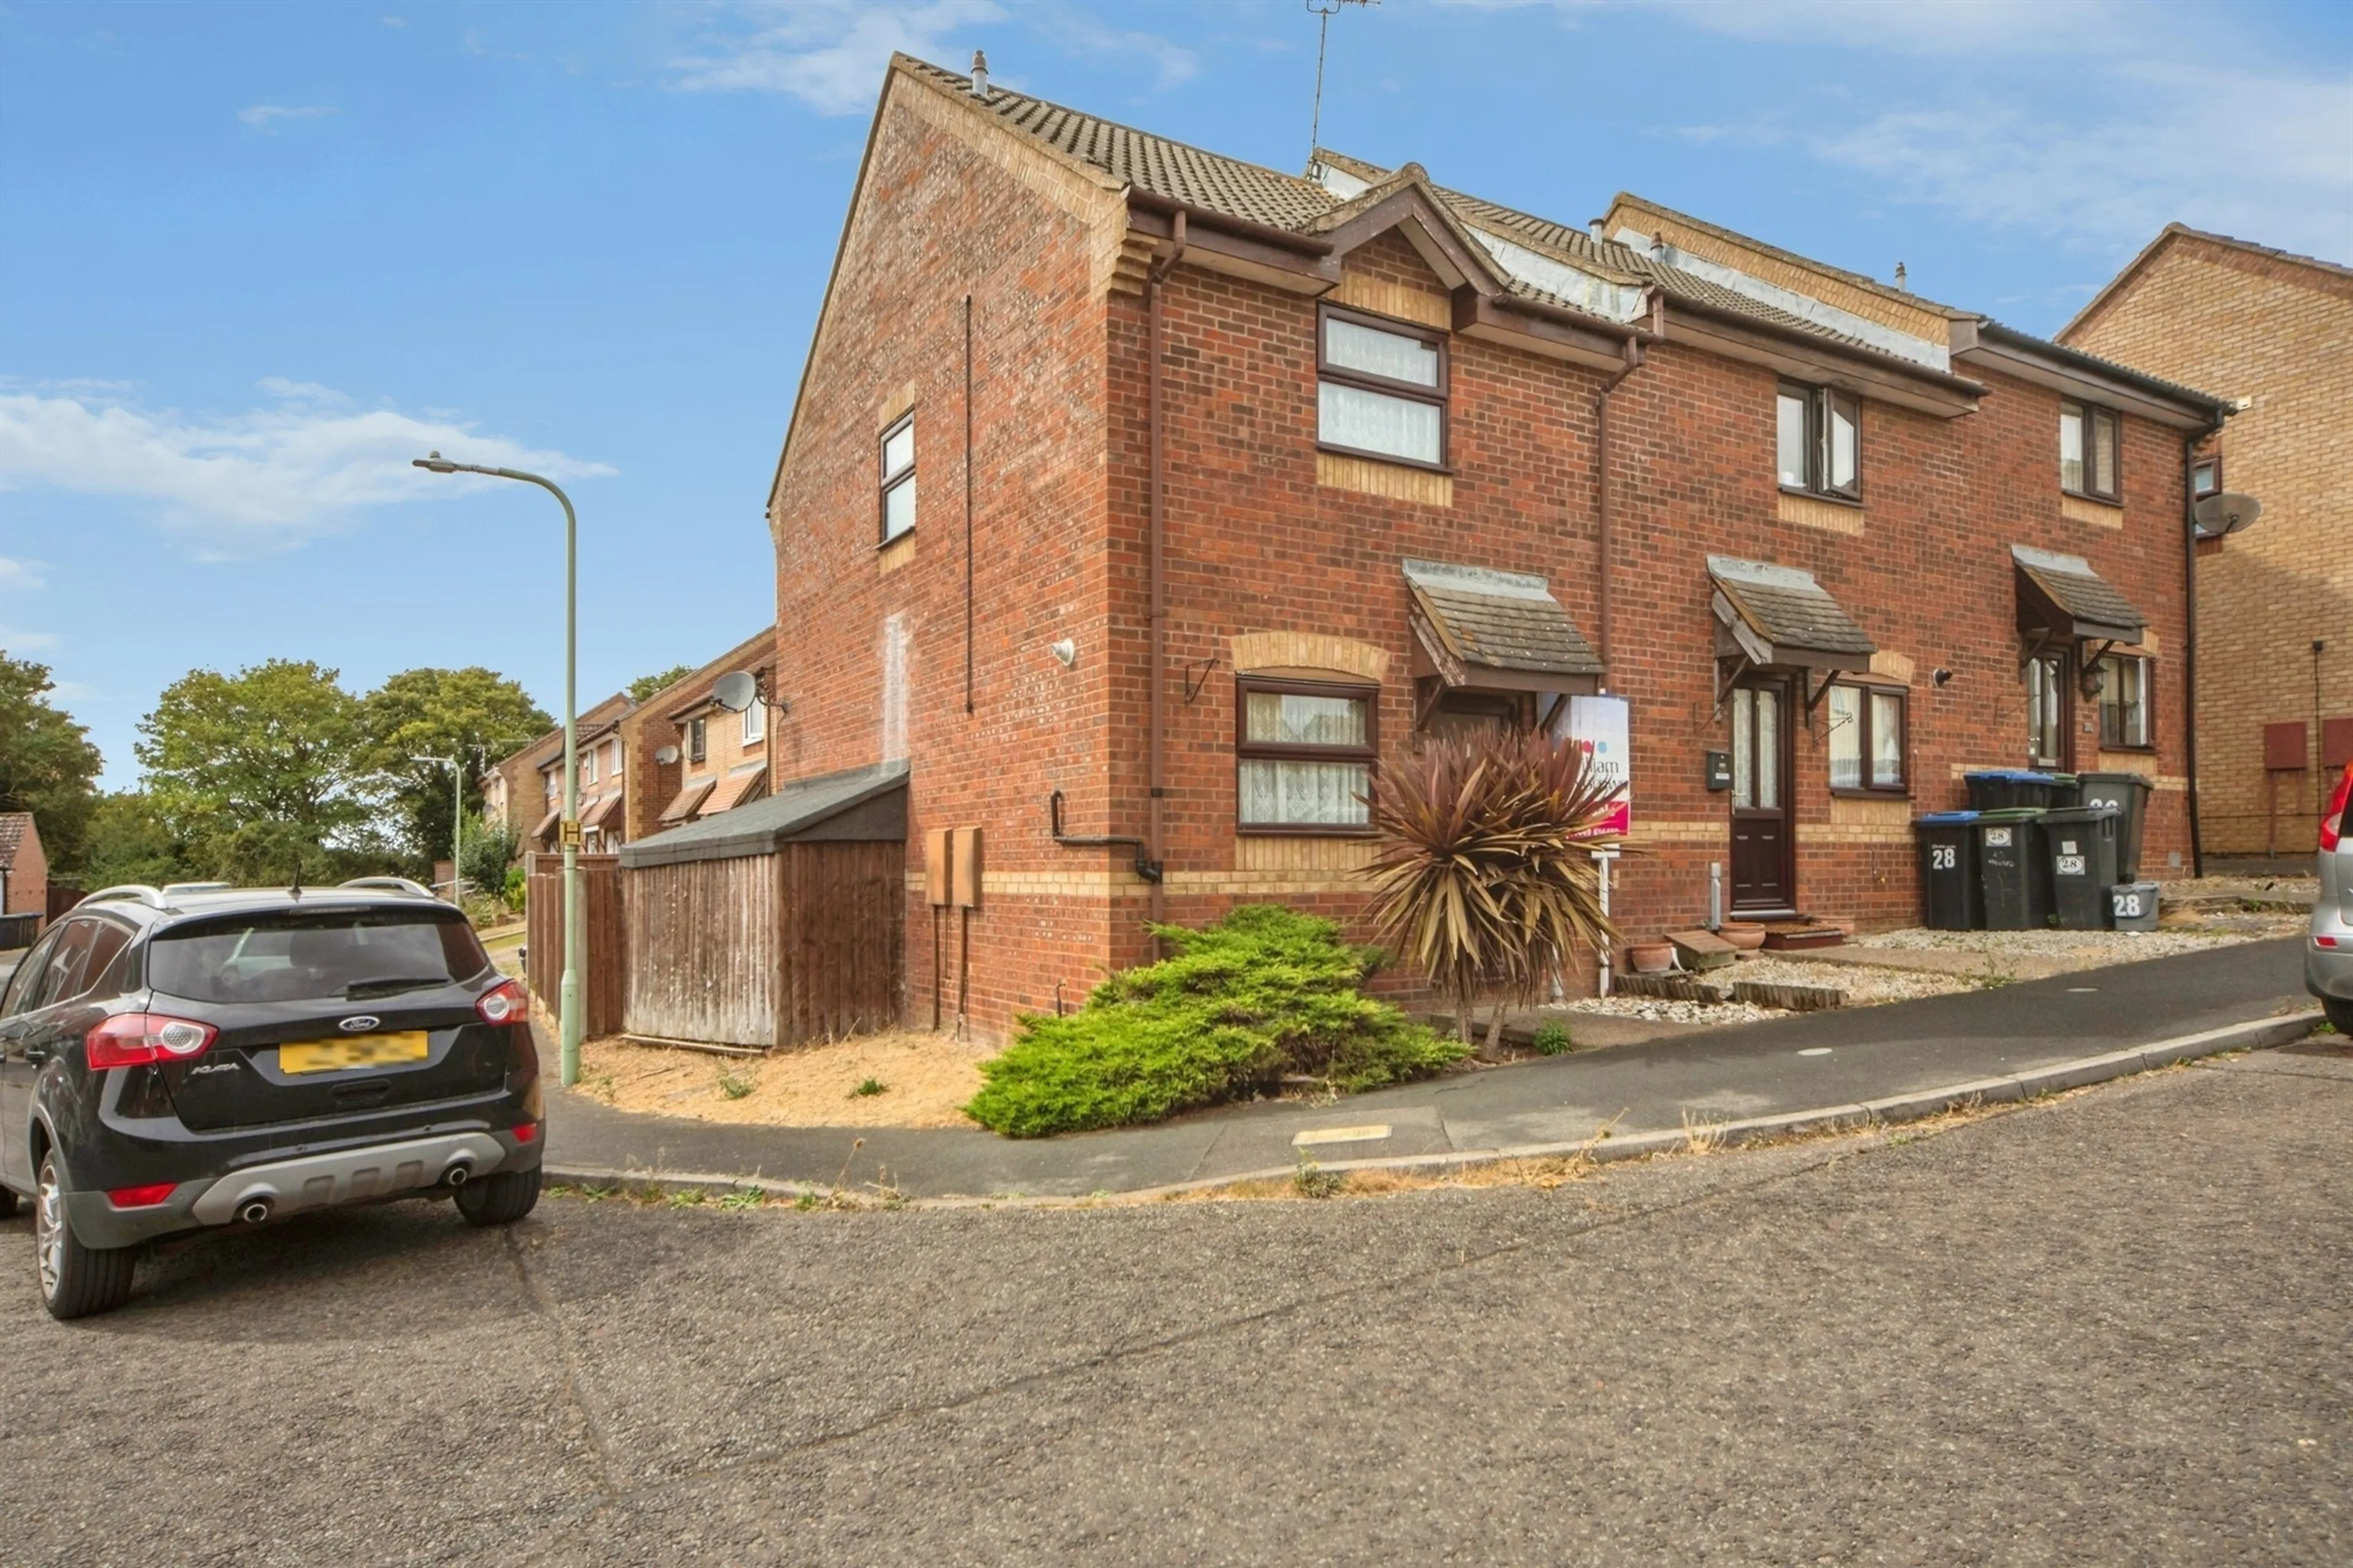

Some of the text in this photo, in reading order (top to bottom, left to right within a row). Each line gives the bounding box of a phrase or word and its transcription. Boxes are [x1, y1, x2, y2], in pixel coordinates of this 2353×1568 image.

[564, 823, 580, 842] H
[1990, 831, 2004, 840] 28
[1932, 849, 1955, 869] 28
[2062, 860, 2077, 868] 28
[2113, 895, 2140, 917] 28
